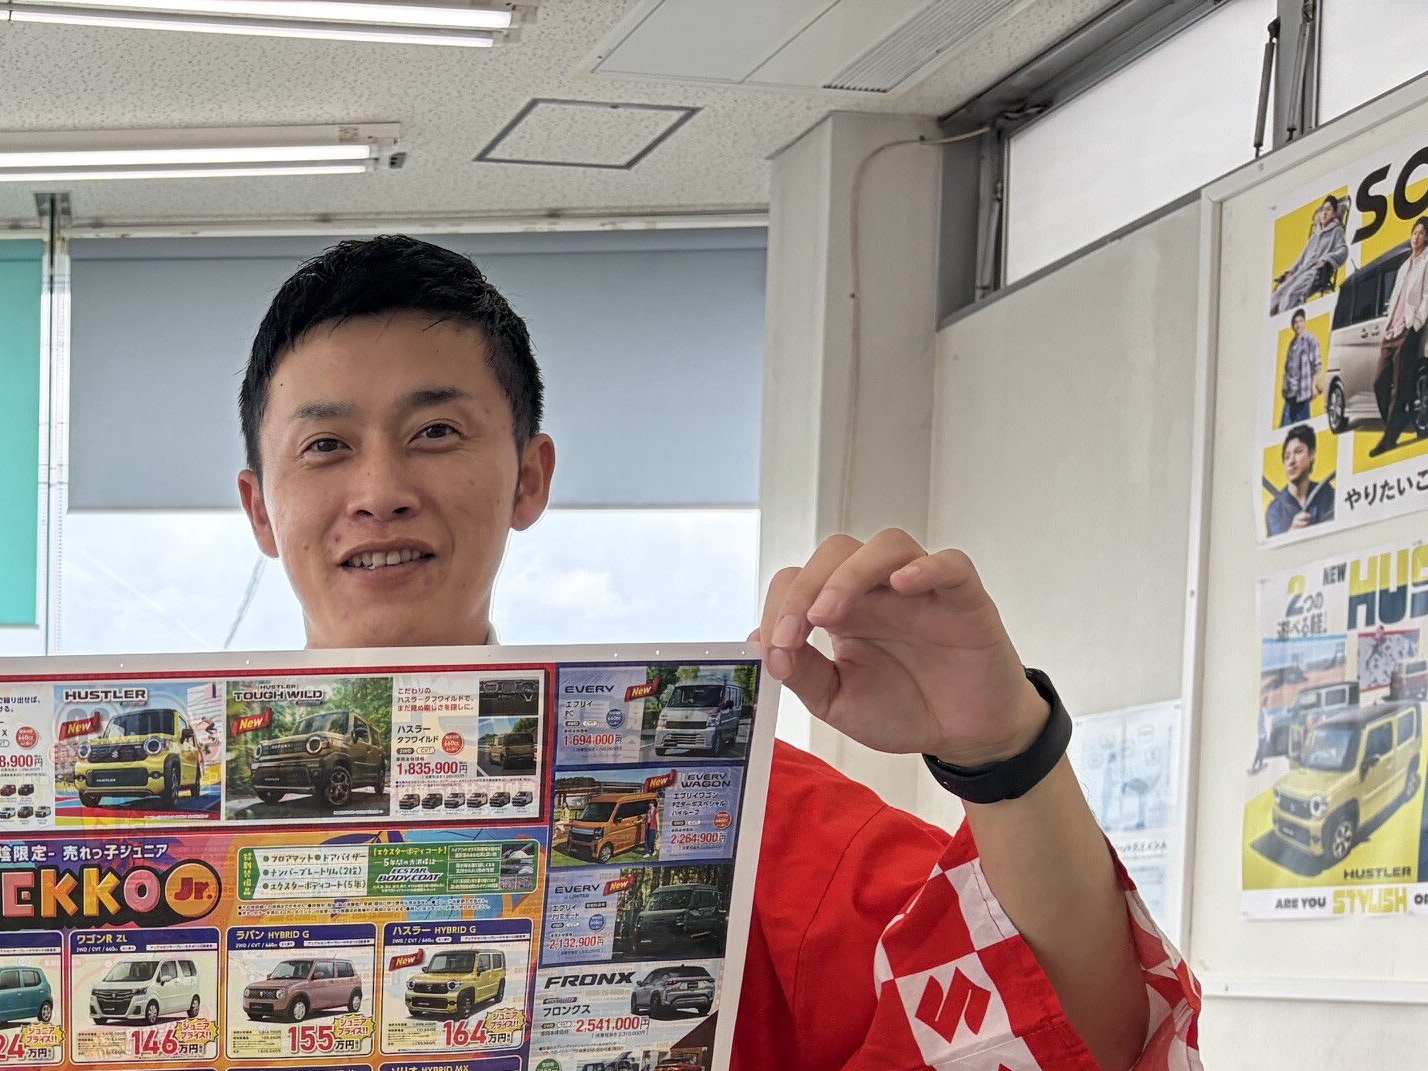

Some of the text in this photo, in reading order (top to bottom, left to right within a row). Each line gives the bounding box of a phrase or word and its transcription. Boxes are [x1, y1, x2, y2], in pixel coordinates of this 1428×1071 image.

[1345, 469, 1428, 510] やりたいこ
[1323, 562, 1347, 586] NEW
[64, 689, 146, 701] HUSTLER
[565, 685, 614, 694] EVERY
[631, 685, 652, 697] New
[234, 690, 323, 701] TOUGH WILD
[565, 700, 593, 708] エブリイ
[67, 720, 91, 733] New
[239, 716, 263, 730] New
[397, 725, 431, 733] ハスラー
[397, 736, 439, 744] タフワイルド
[563, 734, 623, 746] 1,694,000円
[397, 761, 468, 775] 1,835,900円
[681, 780, 731, 788] WAGON
[673, 792, 719, 800] エブリイワゴン
[62, 844, 168, 861] 売れっ子ジュニア
[271, 853, 367, 863] フロアマット ドアバイザー
[378, 874, 410, 882] BODY
[1343, 867, 1411, 880] HUSTLER
[173, 876, 214, 901] Jr.
[554, 884, 600, 894] EVERY
[1275, 897, 1299, 910] ARE
[1301, 896, 1327, 910] YOU
[1332, 887, 1408, 915] STYLISH
[552, 904, 578, 912] エブリイ
[236, 930, 300, 940] ラパン HYBRID
[392, 925, 467, 935] ハスラー HYBRID
[77, 934, 113, 944] ワゴンR
[396, 956, 416, 967] New
[544, 971, 637, 989] FRONX
[542, 1004, 591, 1018] フロンクス
[182, 1021, 210, 1031] ジュニア
[339, 1018, 367, 1027] ジュニア
[575, 1017, 650, 1032] 2,541,000円
[28, 1025, 55, 1034] ジュニア
